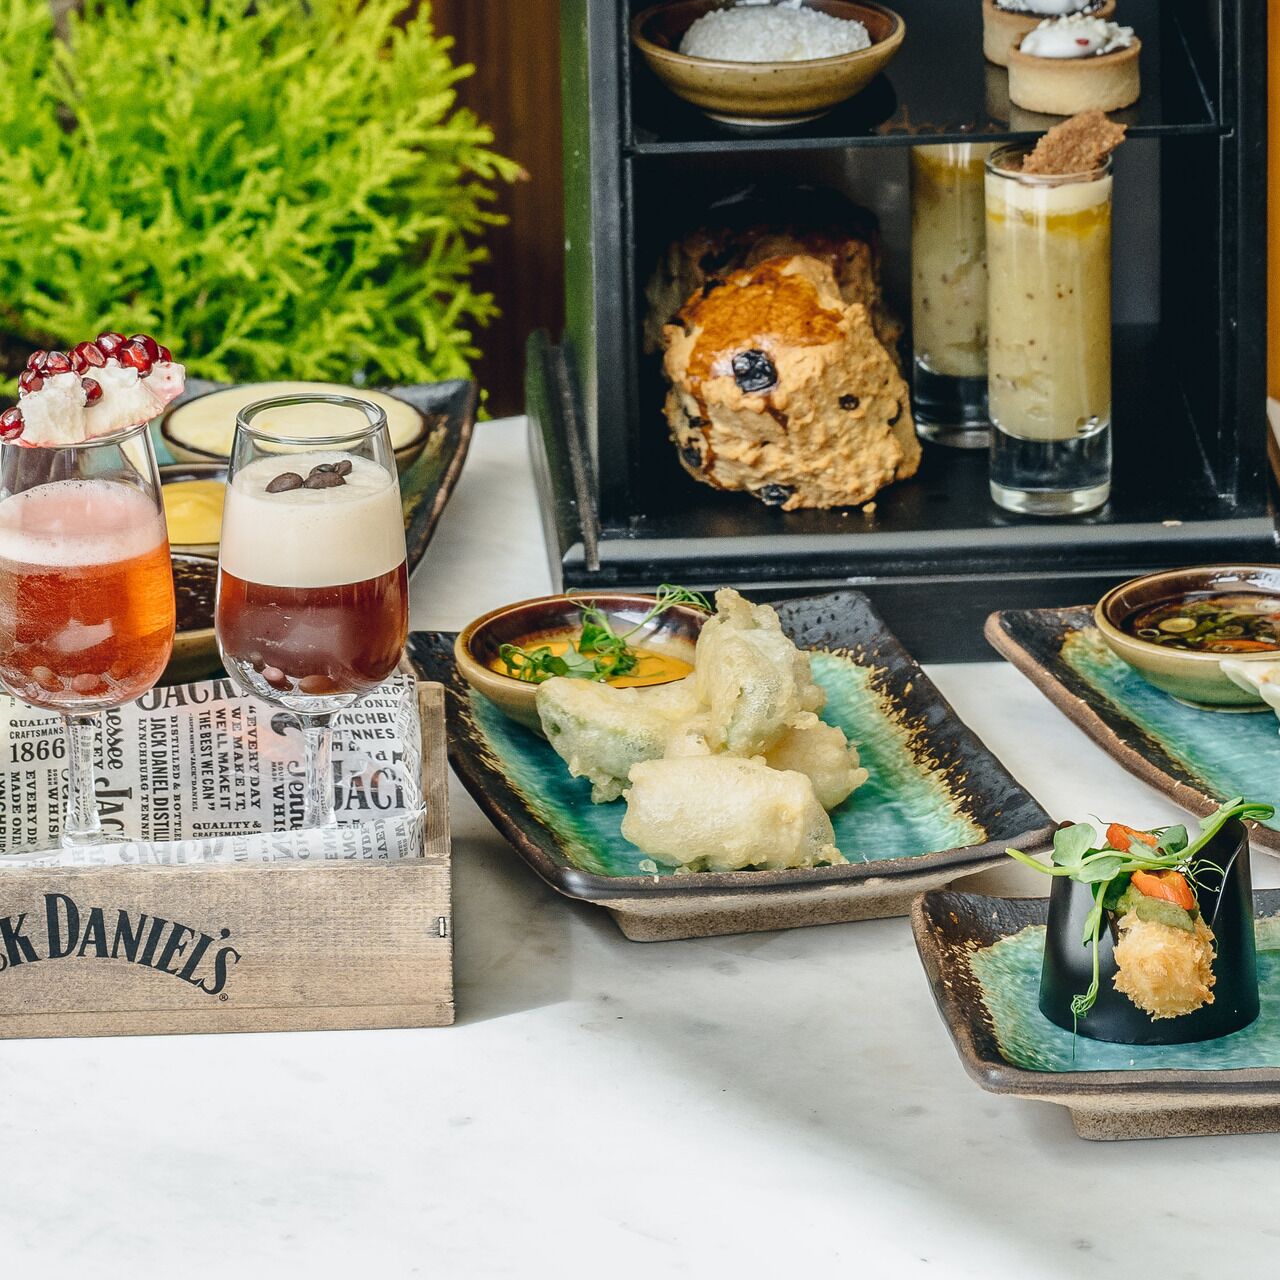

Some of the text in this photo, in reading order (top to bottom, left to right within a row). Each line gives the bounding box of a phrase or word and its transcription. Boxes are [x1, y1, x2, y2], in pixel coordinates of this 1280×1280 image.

[10, 726, 64, 739] CRAFTSMANS
[199, 710, 211, 730] THE
[231, 706, 242, 731] WE
[10, 737, 66, 763] 1866
[170, 715, 181, 779] DISTILLED
[200, 732, 213, 757] BEST
[232, 735, 245, 787] MAKE
[138, 718, 150, 841] LYNCHBURG TENNES
[150, 718, 170, 842] JACK DANIEL DISTILL
[201, 759, 214, 776] WE
[218, 751, 231, 793] MAKE
[11, 772, 21, 815] MADE
[26, 770, 37, 825] EVERY
[173, 783, 182, 791] &
[250, 776, 262, 809] DAY
[220, 797, 231, 811] IT
[273, 783, 285, 832] WHIS
[192, 820, 262, 830] QUALITY &
[43, 893, 242, 995] DANIEL'S
